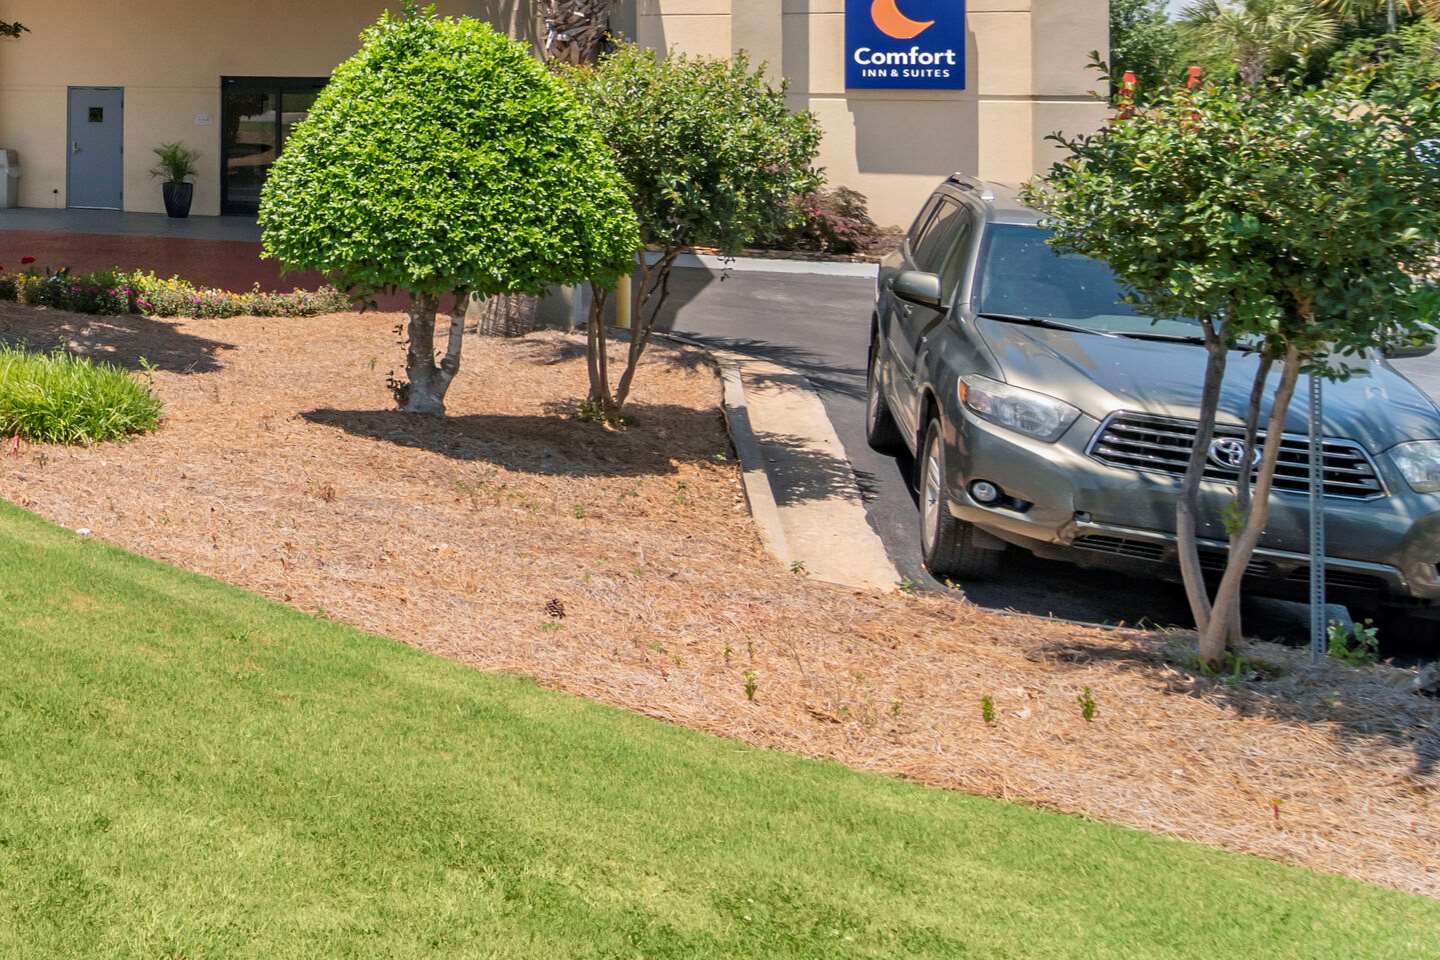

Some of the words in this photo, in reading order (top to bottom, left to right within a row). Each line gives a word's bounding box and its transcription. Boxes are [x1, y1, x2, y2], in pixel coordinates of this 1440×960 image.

[853, 46, 957, 65] Comfort
[861, 69, 888, 78] INN
[890, 68, 900, 78] &
[902, 68, 951, 78] SUITES
